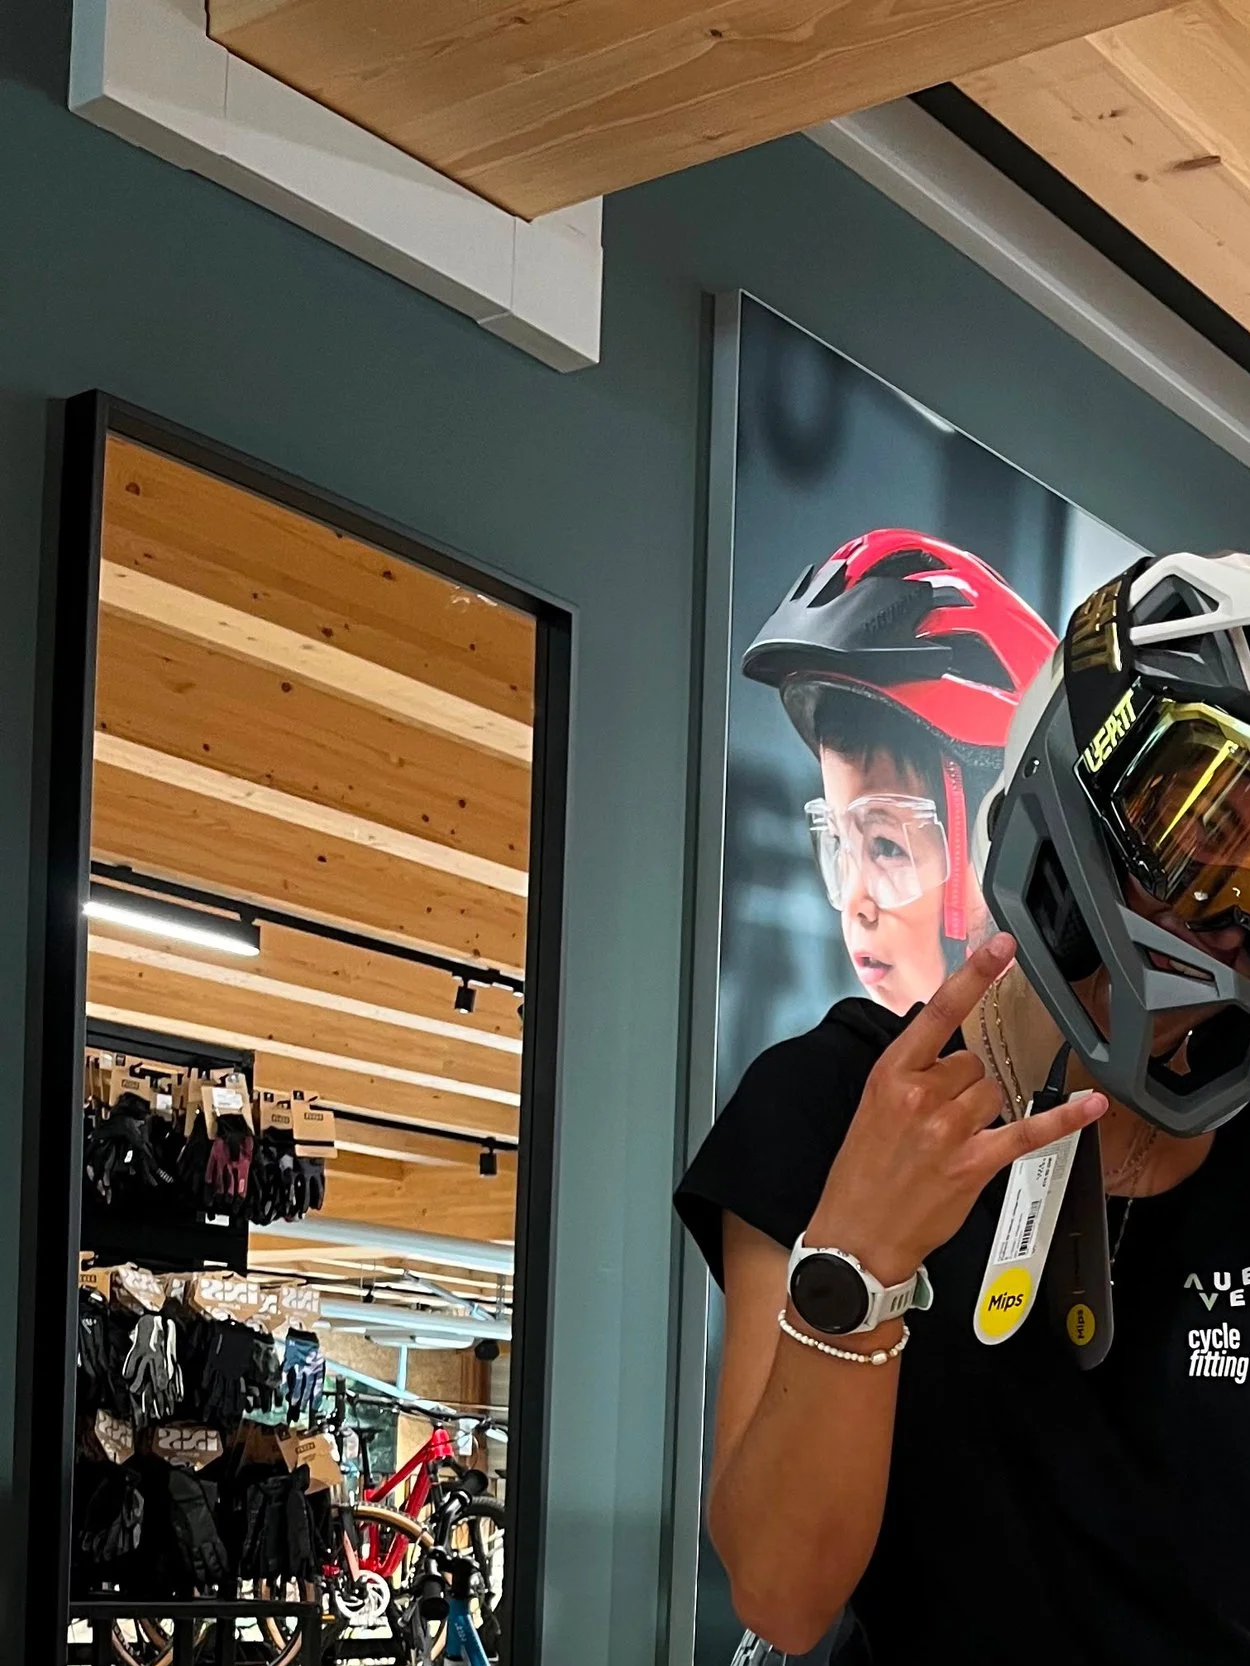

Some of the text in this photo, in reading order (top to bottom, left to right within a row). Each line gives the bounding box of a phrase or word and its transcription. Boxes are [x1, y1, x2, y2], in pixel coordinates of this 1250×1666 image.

[1083, 687, 1138, 773] LEATT
[988, 1292, 1024, 1312] Mips
[1076, 1309, 1086, 1340] Mips
[1188, 1322, 1240, 1354] cycle
[1189, 1350, 1250, 1385] fitting
